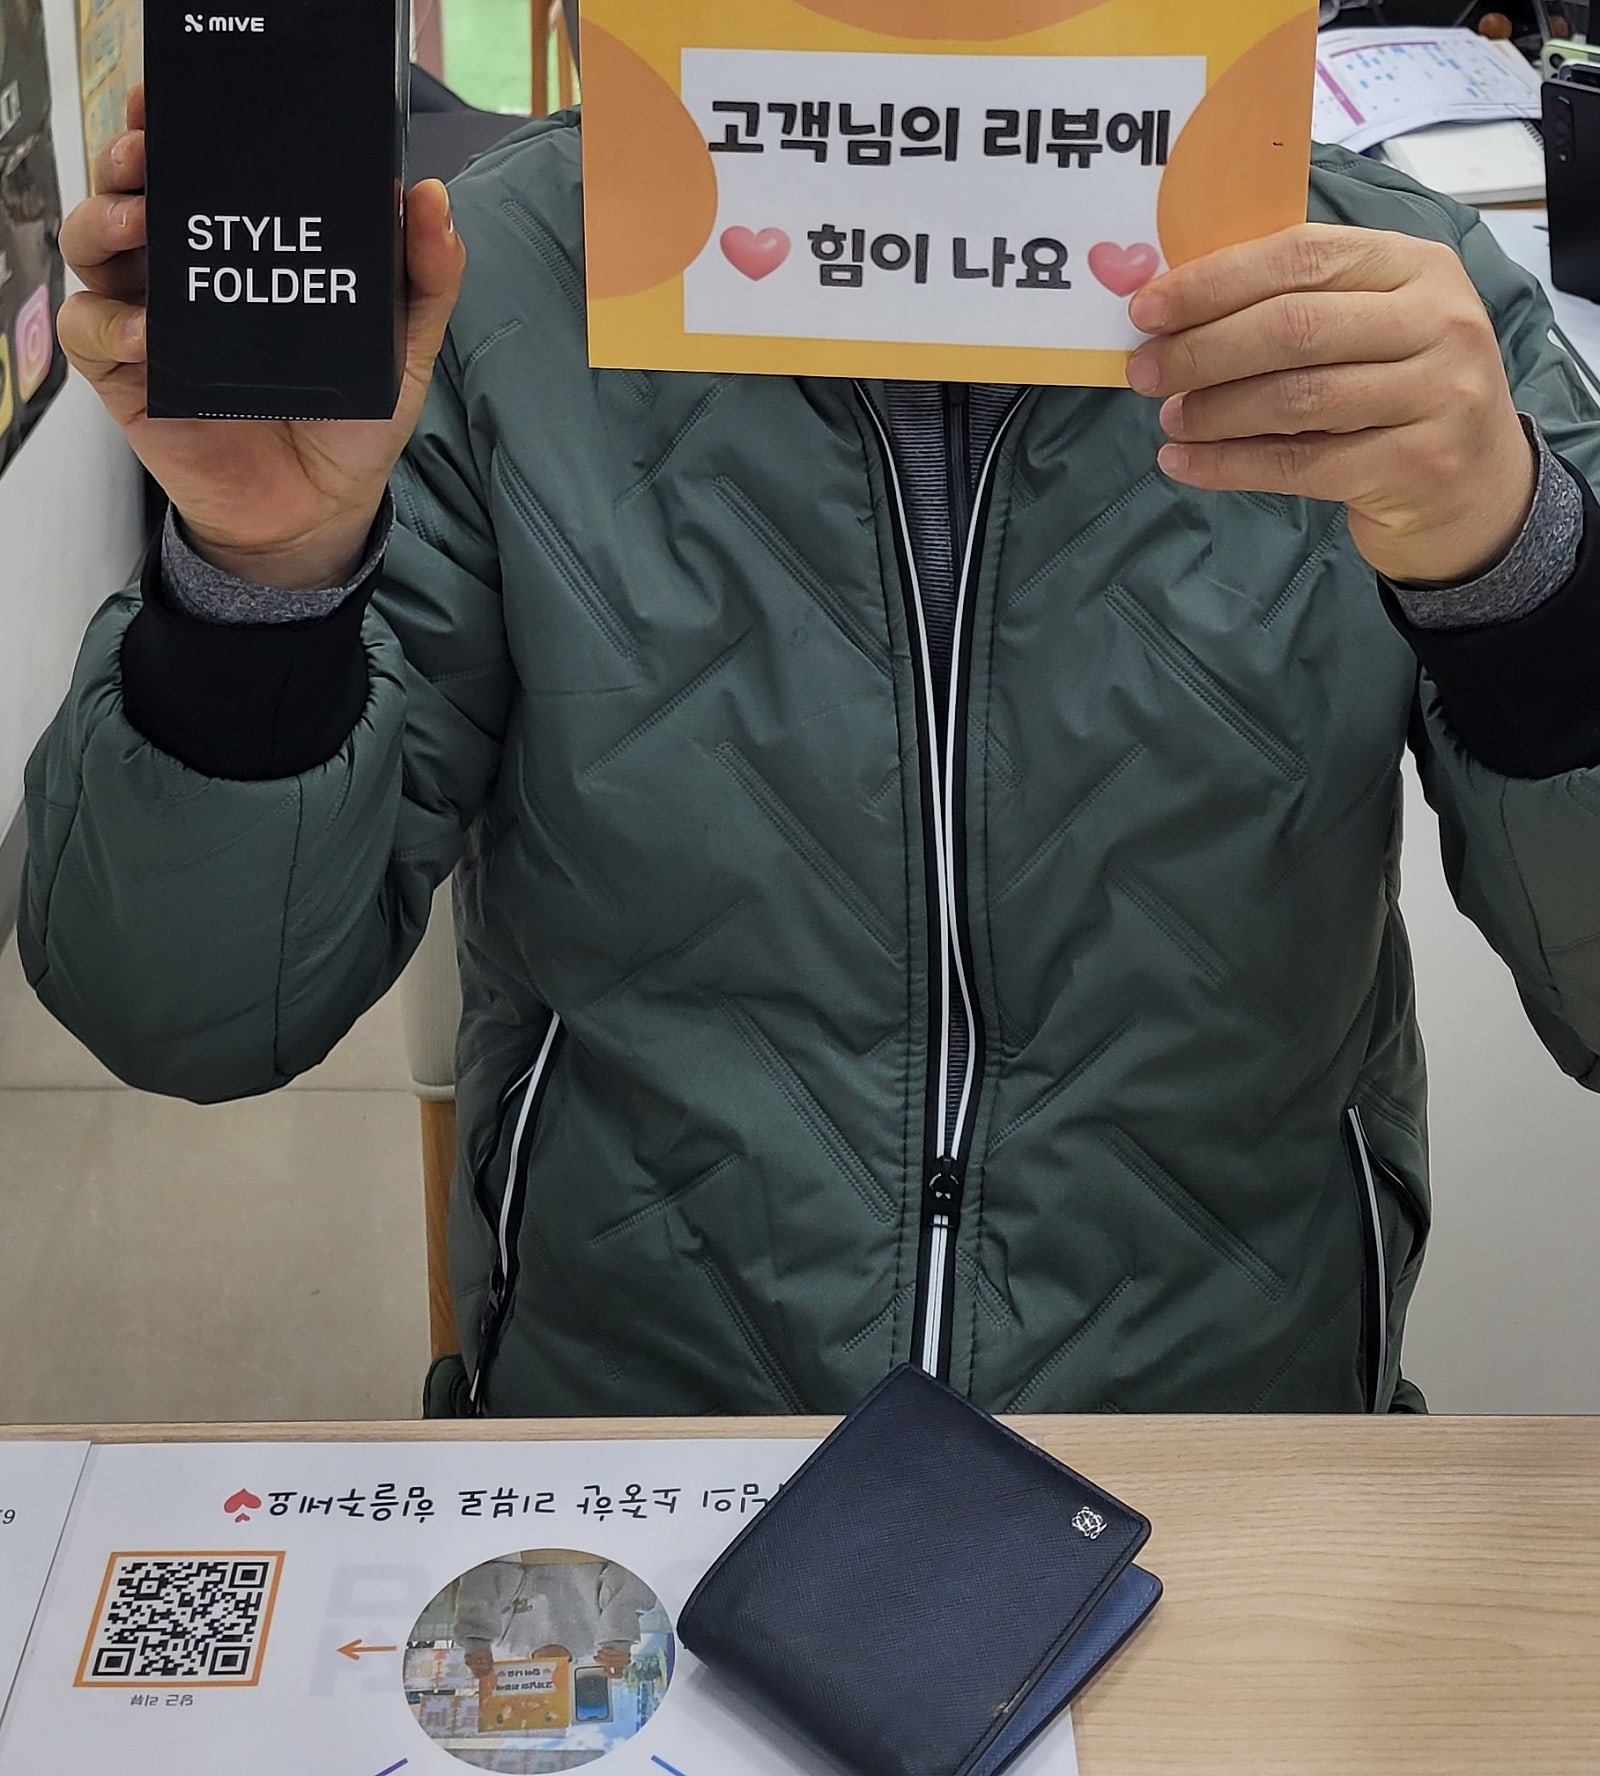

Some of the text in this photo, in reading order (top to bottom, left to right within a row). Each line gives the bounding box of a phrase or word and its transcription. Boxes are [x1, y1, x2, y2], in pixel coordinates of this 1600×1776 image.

[208, 16, 265, 33] MIVE
[707, 99, 1172, 169] 고객님의 리뷰에
[187, 214, 323, 252] STYLE
[807, 223, 1072, 290] 힘이 나요
[187, 267, 357, 305] FOLDER
[458, 1487, 556, 1518] 리뷰로
[576, 1483, 682, 1521] 소중한
[701, 1482, 774, 1514] 님의
[130, 1694, 194, 1708] 당근 리뷰
